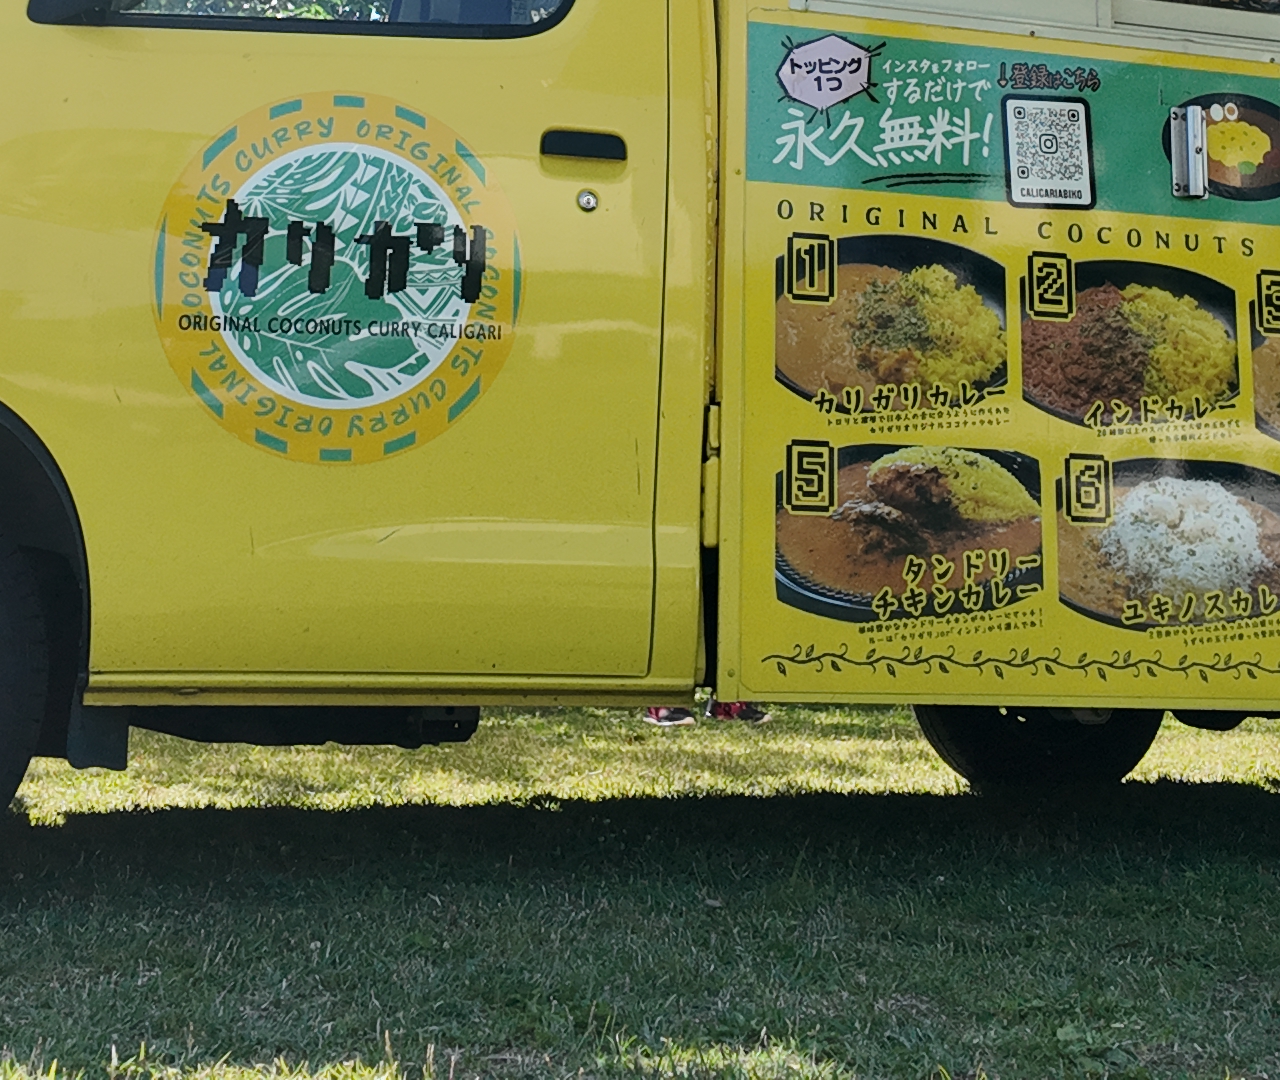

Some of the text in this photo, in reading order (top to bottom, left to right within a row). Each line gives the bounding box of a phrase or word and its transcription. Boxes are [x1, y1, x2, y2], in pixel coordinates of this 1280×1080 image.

[789, 56, 862, 76] トッピング
[813, 75, 844, 93] 1つ
[882, 77, 992, 106] するだけで
[234, 116, 335, 173] CURRY
[356, 119, 482, 215] ORIGINAL
[776, 198, 999, 236] ORIGINAL
[1036, 221, 1255, 258] COCONUTS
[197, 198, 487, 304] カリガリ
[178, 313, 502, 341] ORIGINAL COCONUTS CURRY CALIGARI
[814, 382, 1006, 414] カリガリカレー
[1085, 397, 1237, 428] インドカレー
[904, 550, 1040, 583] タンドリー
[874, 582, 1040, 618] チキンカレー
